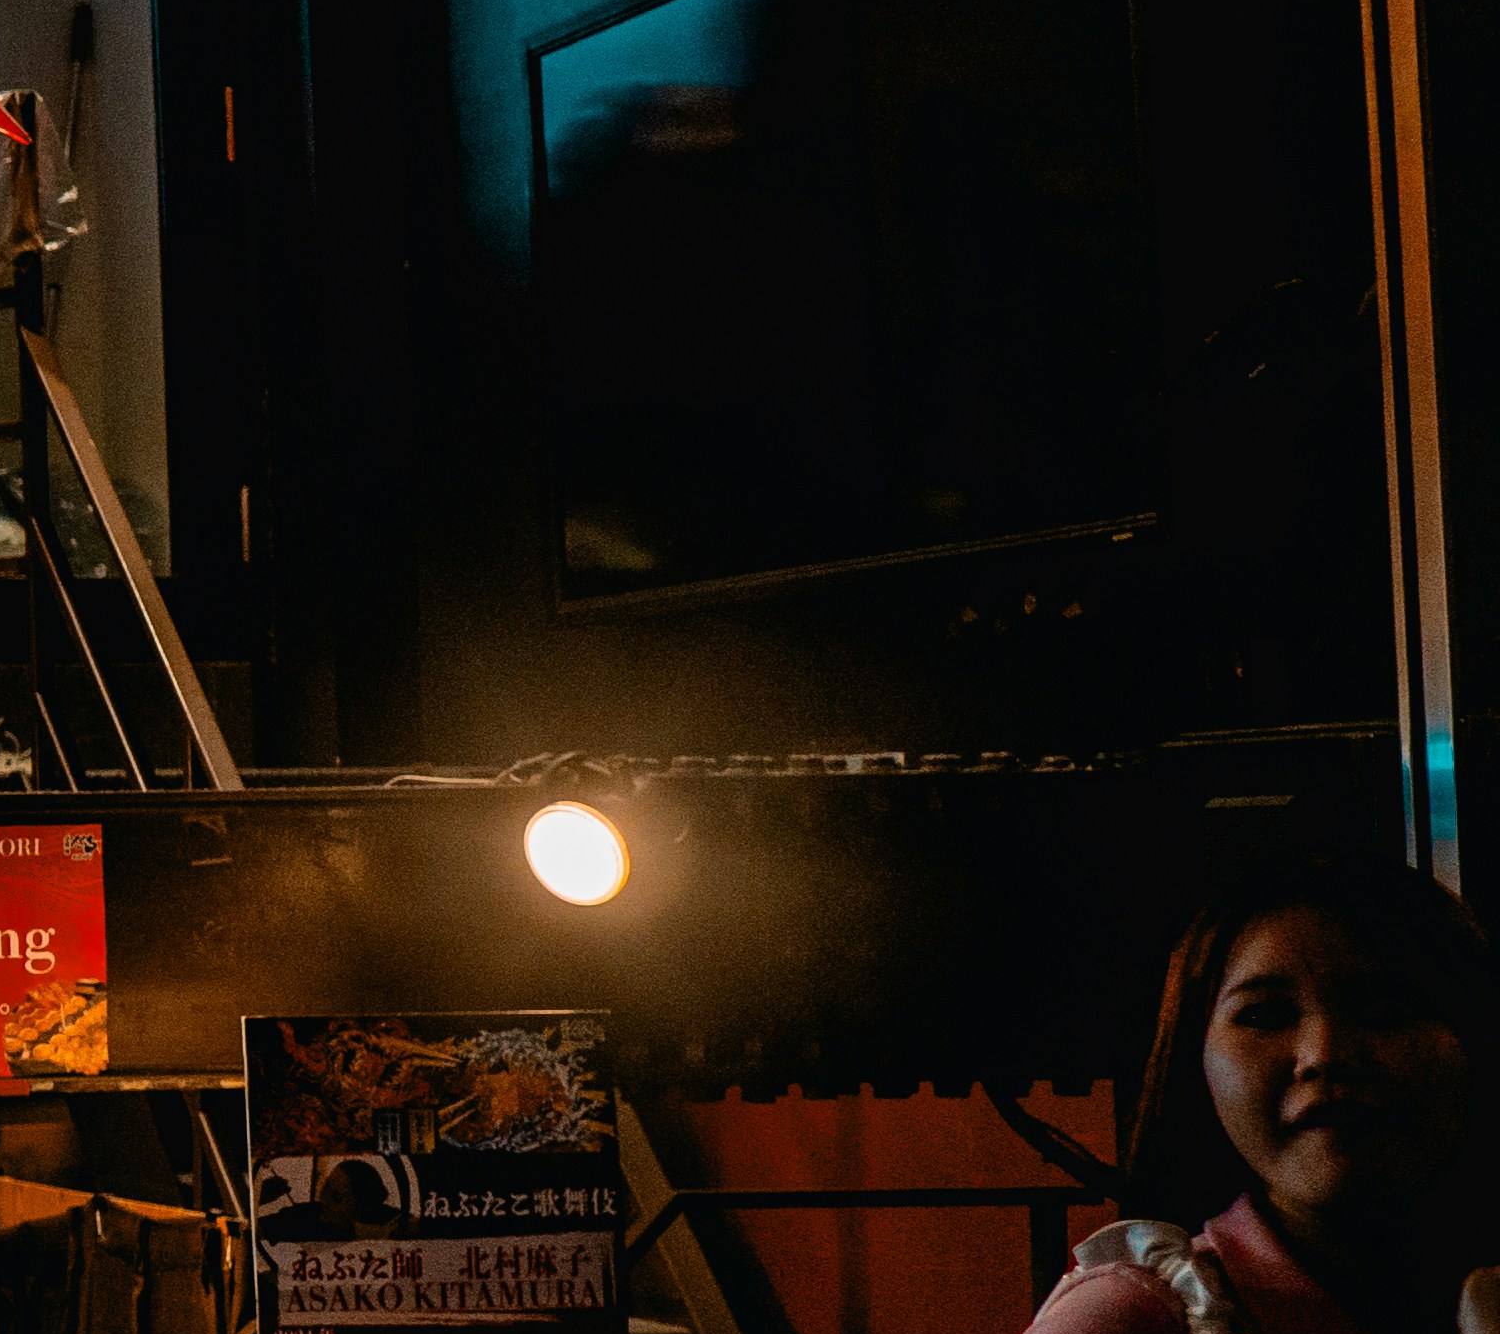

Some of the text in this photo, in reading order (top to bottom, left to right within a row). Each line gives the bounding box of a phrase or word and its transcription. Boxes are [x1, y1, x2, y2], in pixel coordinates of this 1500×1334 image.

[424, 1187, 619, 1219] ねぶたこ歌舞伎
[286, 1278, 600, 1314] ASAKO KITAMURA
